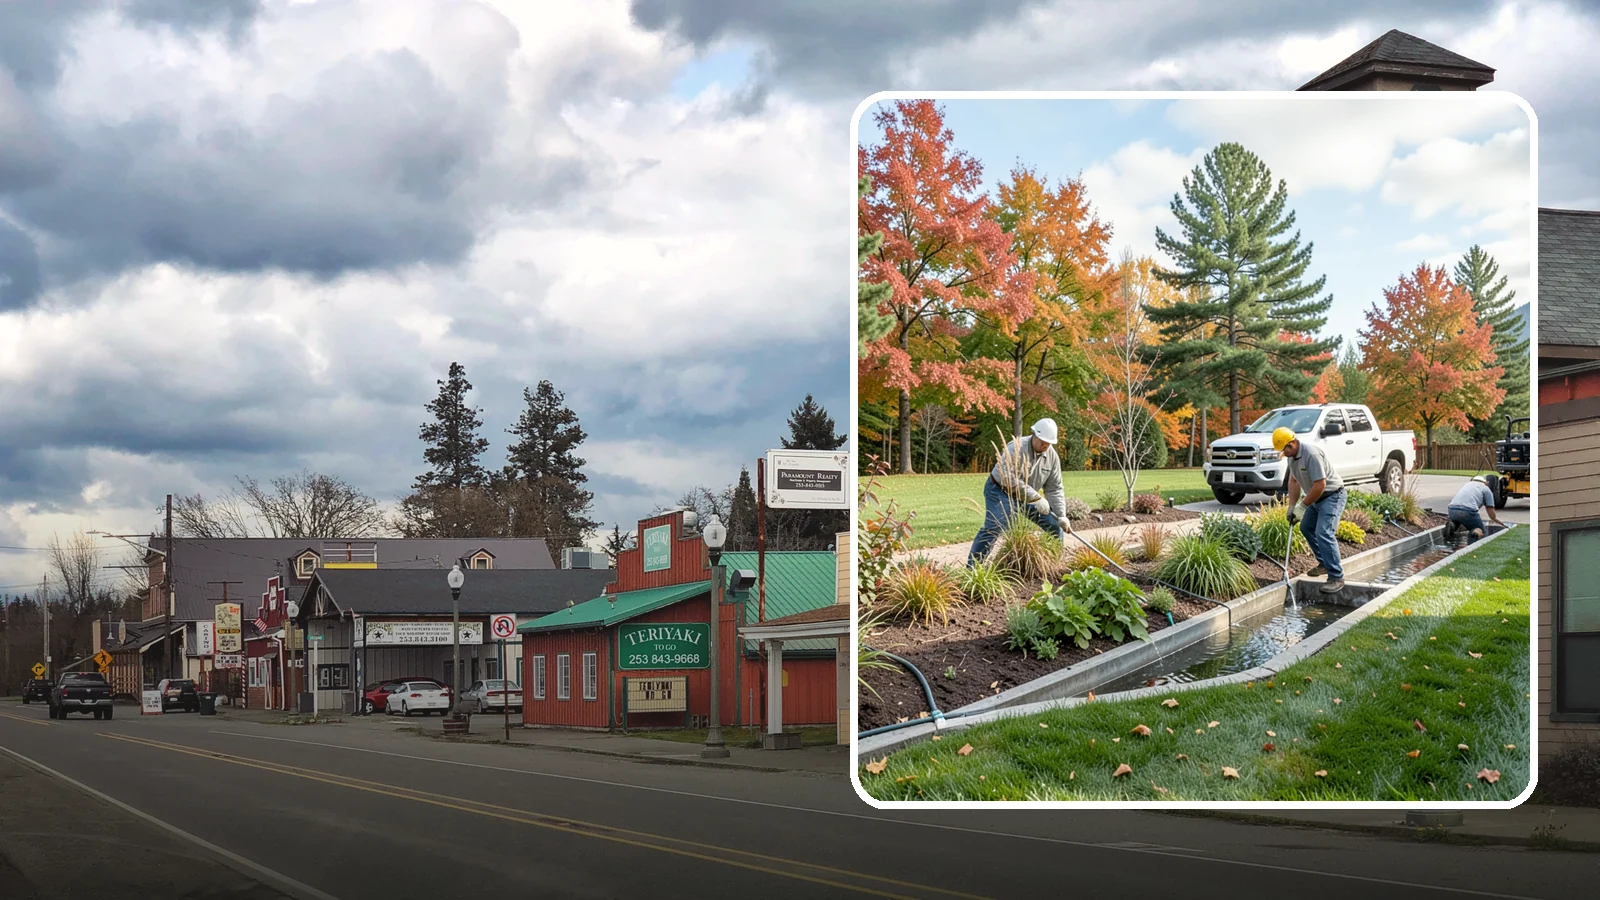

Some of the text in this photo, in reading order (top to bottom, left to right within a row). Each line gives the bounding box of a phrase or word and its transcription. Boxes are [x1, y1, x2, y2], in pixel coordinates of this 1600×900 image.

[781, 471, 839, 480] PARAMOUNT REALTY
[624, 627, 703, 646] TERIYAKI
[653, 643, 677, 651] TO GO
[628, 653, 700, 665] 253 843-9668
[639, 681, 673, 691] TERIYAKI
